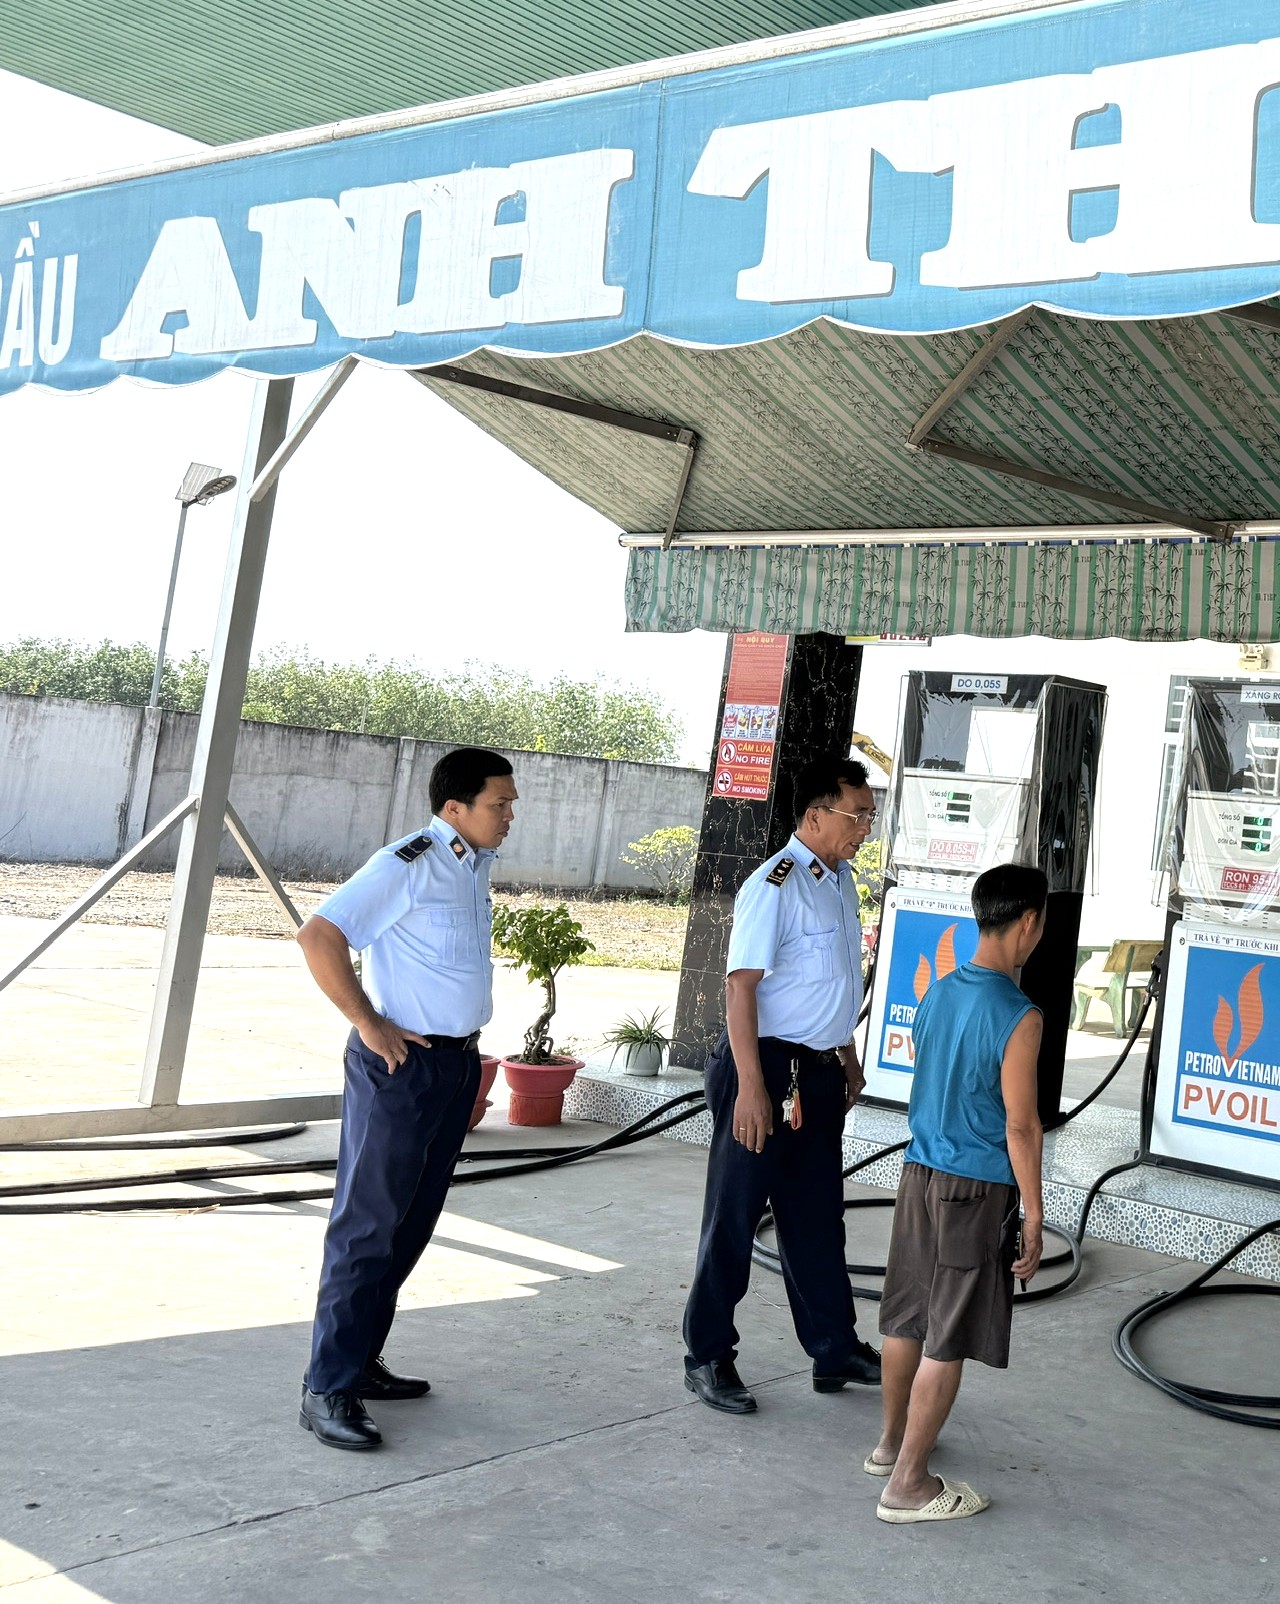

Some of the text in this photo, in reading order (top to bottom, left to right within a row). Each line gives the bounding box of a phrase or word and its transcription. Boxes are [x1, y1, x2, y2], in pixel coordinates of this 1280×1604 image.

[0, 220, 78, 370] ẦU
[100, 148, 635, 362] ANH
[957, 679, 972, 688] DO
[736, 755, 770, 765] NO FIRE
[741, 786, 766, 795] SMOKING
[1225, 871, 1250, 883] RON
[1183, 1084, 1277, 1127] PVOIL
